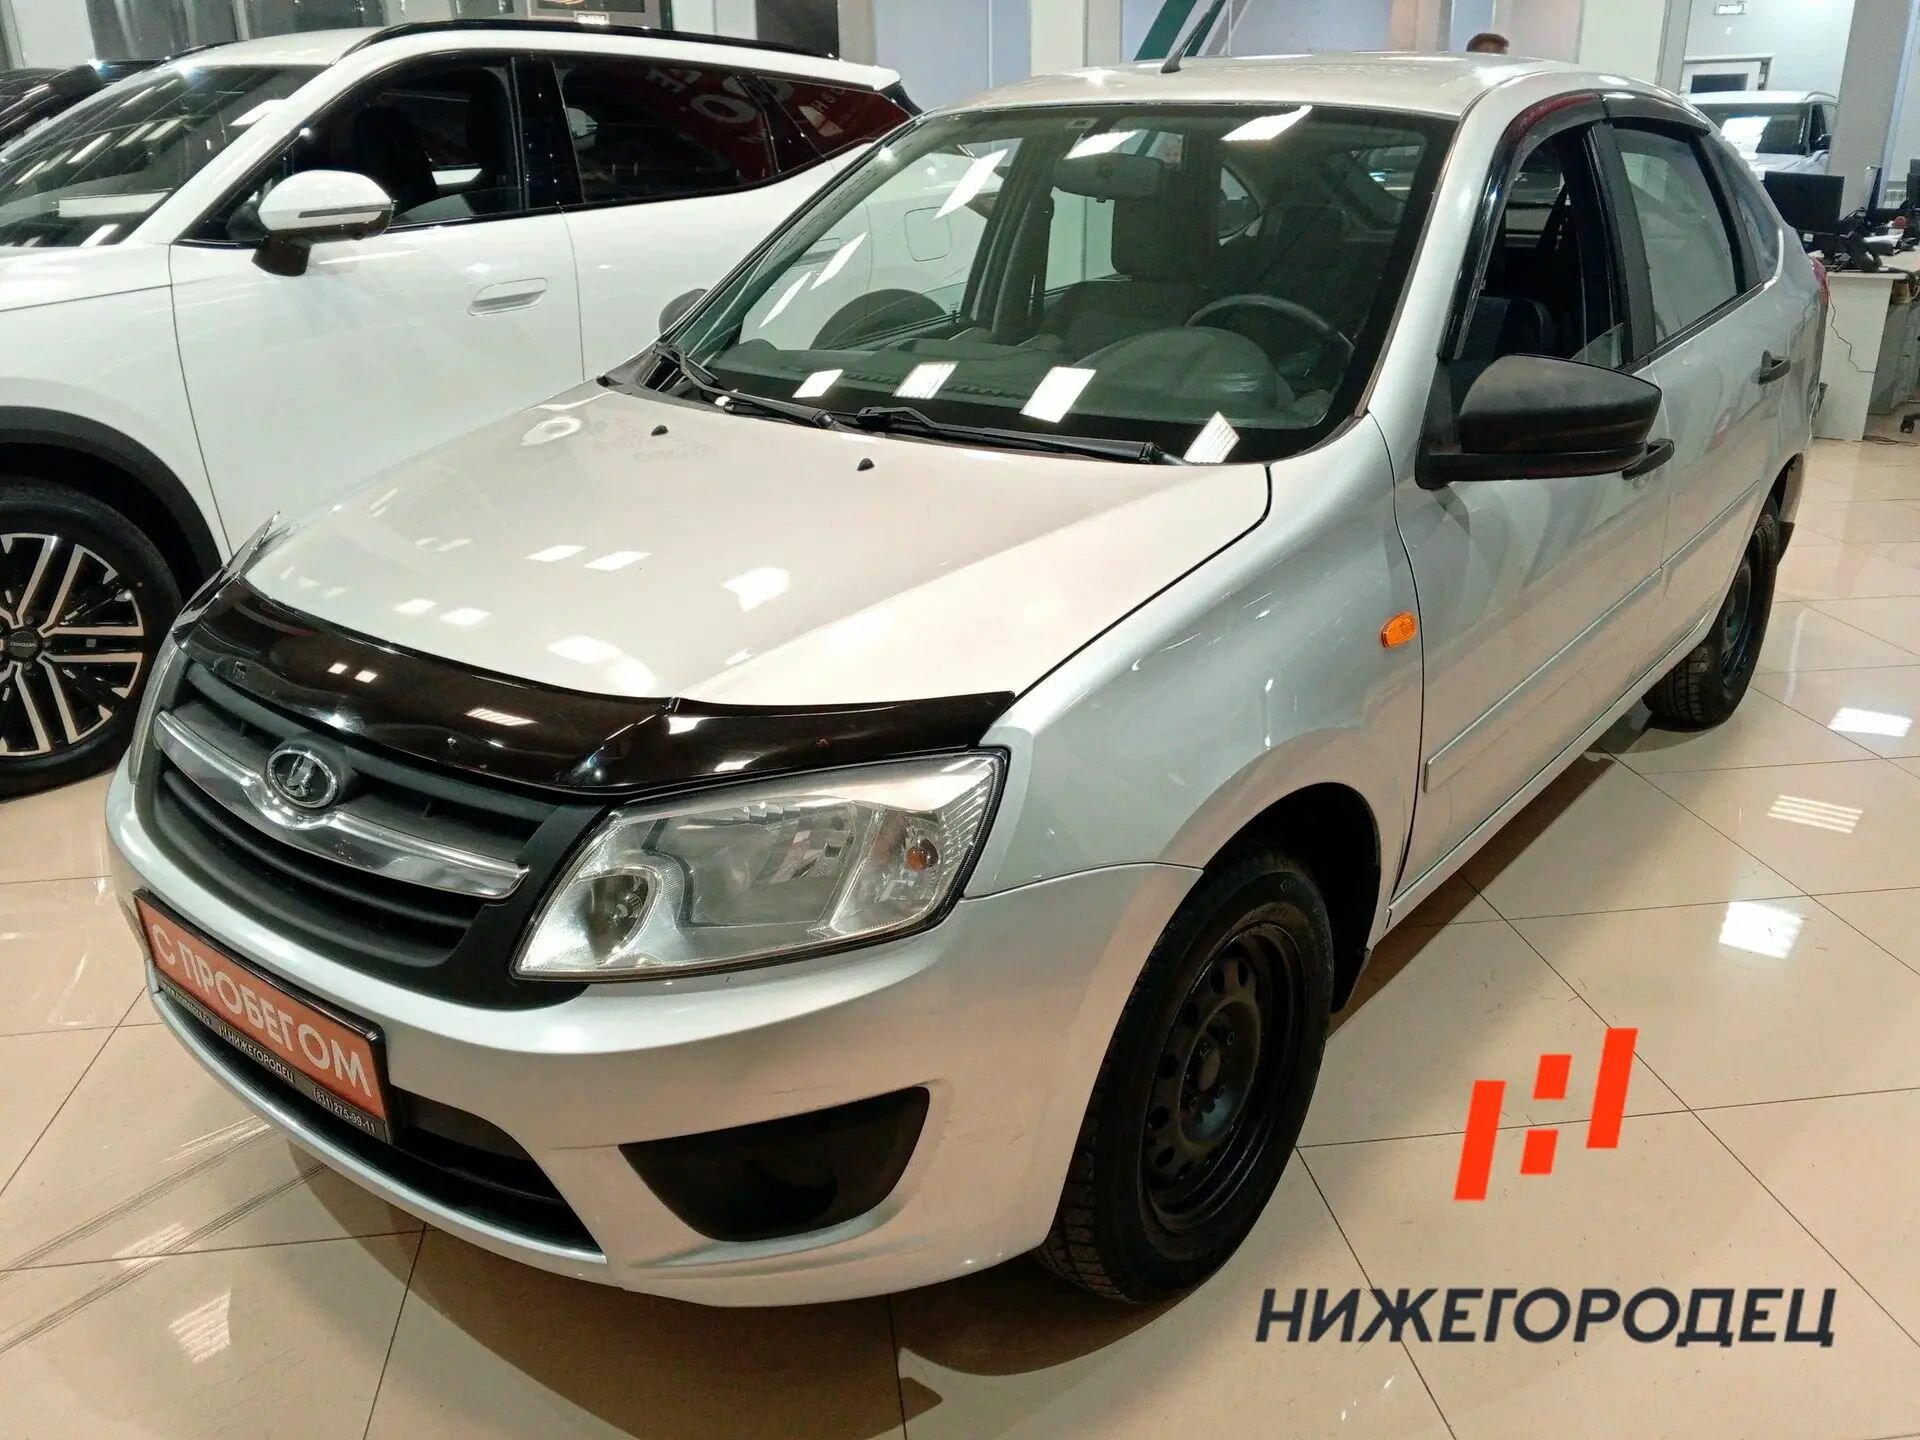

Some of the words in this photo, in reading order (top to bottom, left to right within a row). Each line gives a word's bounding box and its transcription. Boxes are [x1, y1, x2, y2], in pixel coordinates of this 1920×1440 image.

[152, 923, 176, 966] С
[177, 940, 373, 1099] ПРОБЕГОМ
[228, 1032, 296, 1084] НИЖЕГОРОДЕЦ
